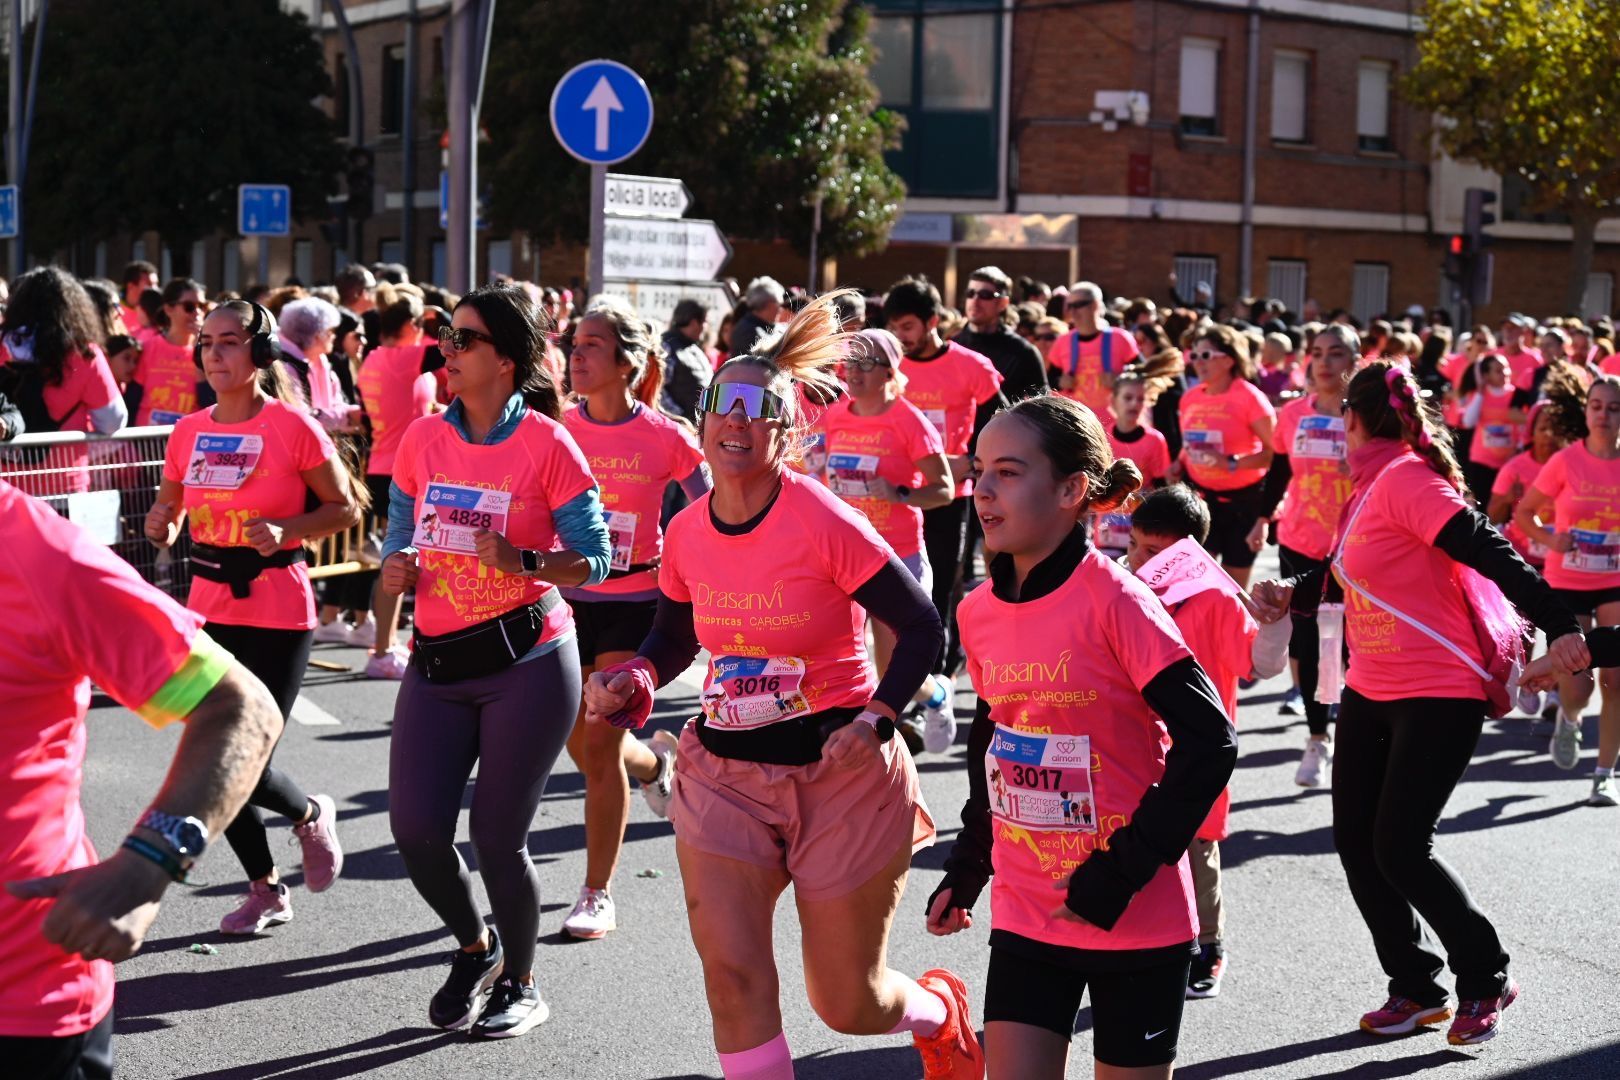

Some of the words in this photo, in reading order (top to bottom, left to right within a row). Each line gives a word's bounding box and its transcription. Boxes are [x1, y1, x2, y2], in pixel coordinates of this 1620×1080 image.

[607, 184, 643, 206] olicia
[648, 185, 680, 208] local
[214, 453, 248, 467] 3923
[587, 452, 642, 470] asanvi
[448, 509, 493, 529] 4828
[454, 574, 526, 591] Carrera
[473, 586, 526, 604] Mujer
[749, 611, 811, 627] CAROBELS
[721, 644, 768, 655] SUZUKI
[733, 676, 781, 697] 3016
[1031, 689, 1097, 704] CAROBELS
[1001, 740, 1016, 752] SCDS
[1051, 755, 1082, 763] almom
[1012, 764, 1063, 791] 3017
[1023, 794, 1060, 807] Carrera
[1031, 804, 1060, 815] Mujer
